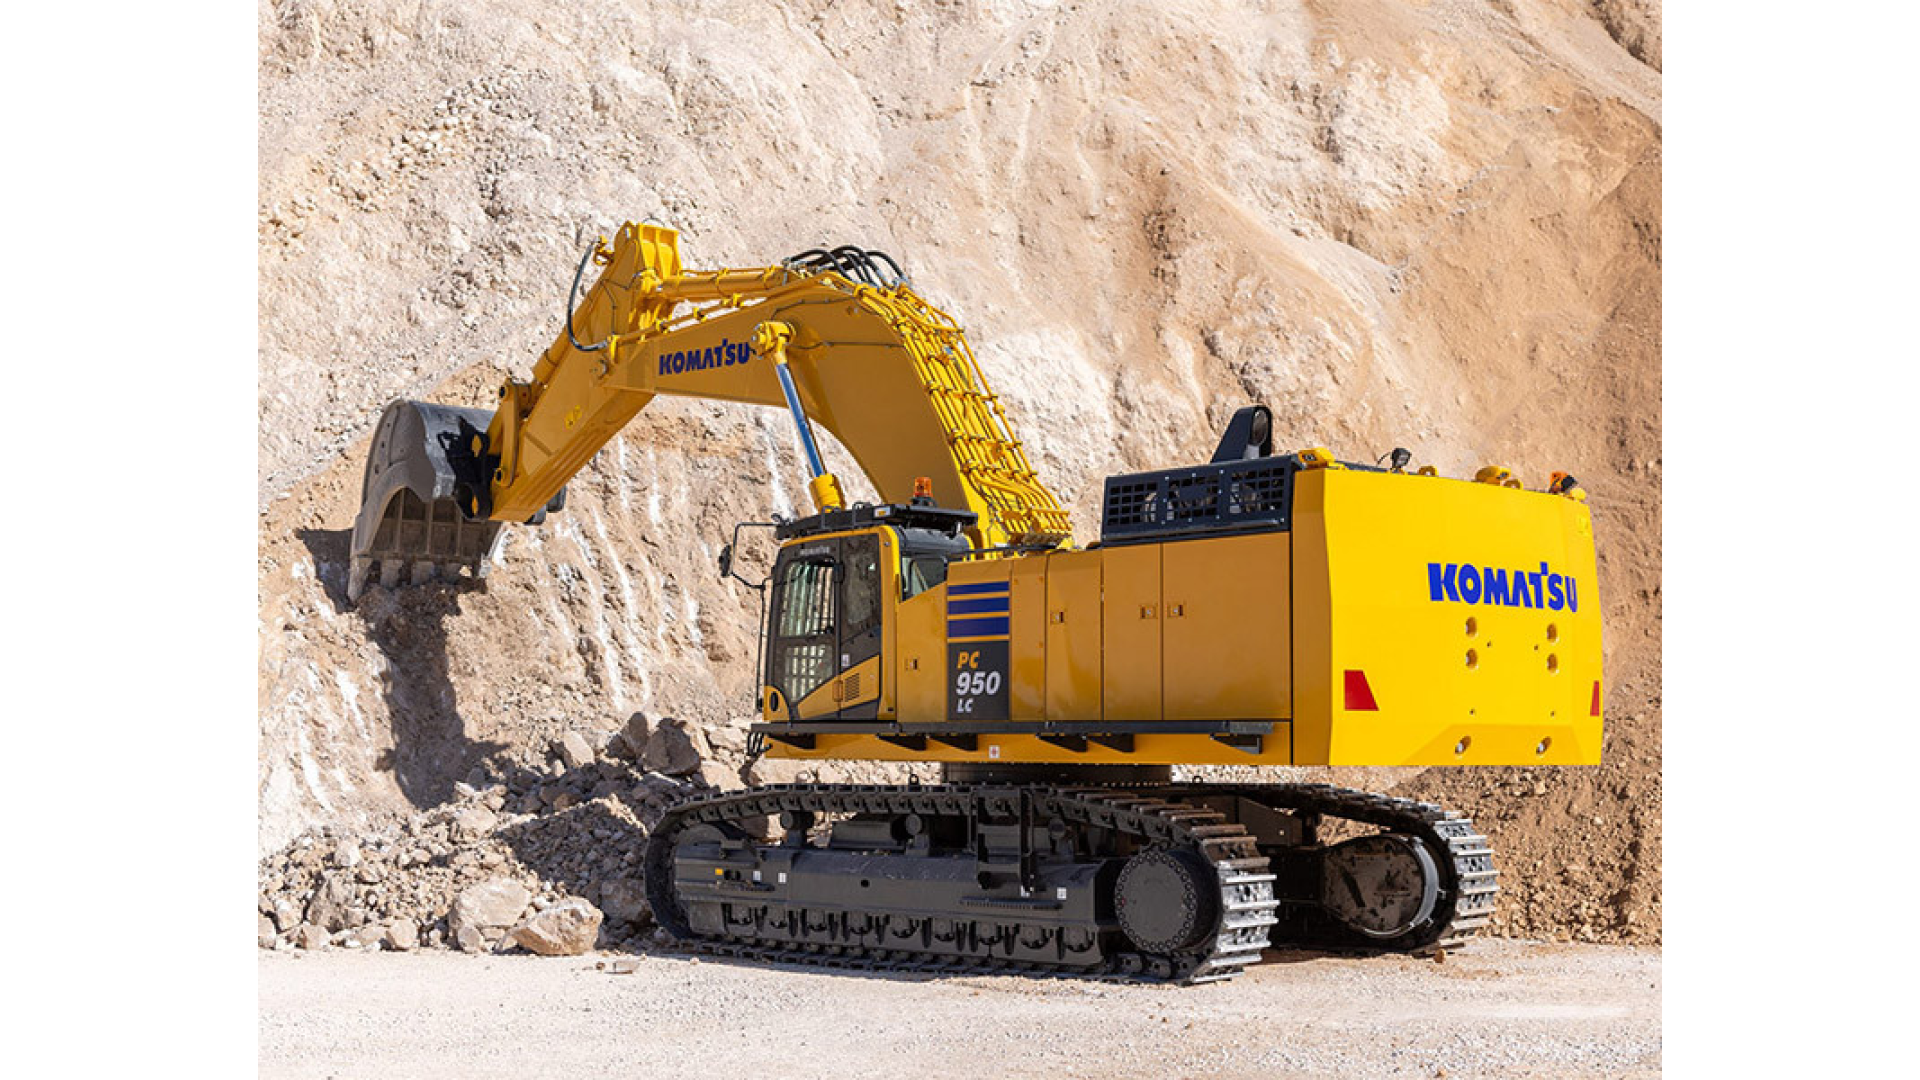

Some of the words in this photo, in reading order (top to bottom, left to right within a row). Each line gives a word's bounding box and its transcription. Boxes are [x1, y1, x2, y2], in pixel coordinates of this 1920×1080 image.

[659, 338, 750, 375] KOMATSU
[1427, 561, 1578, 613] KOMATSU
[956, 651, 980, 669] PC
[956, 671, 1001, 696] 950
[956, 698, 974, 713] LC
